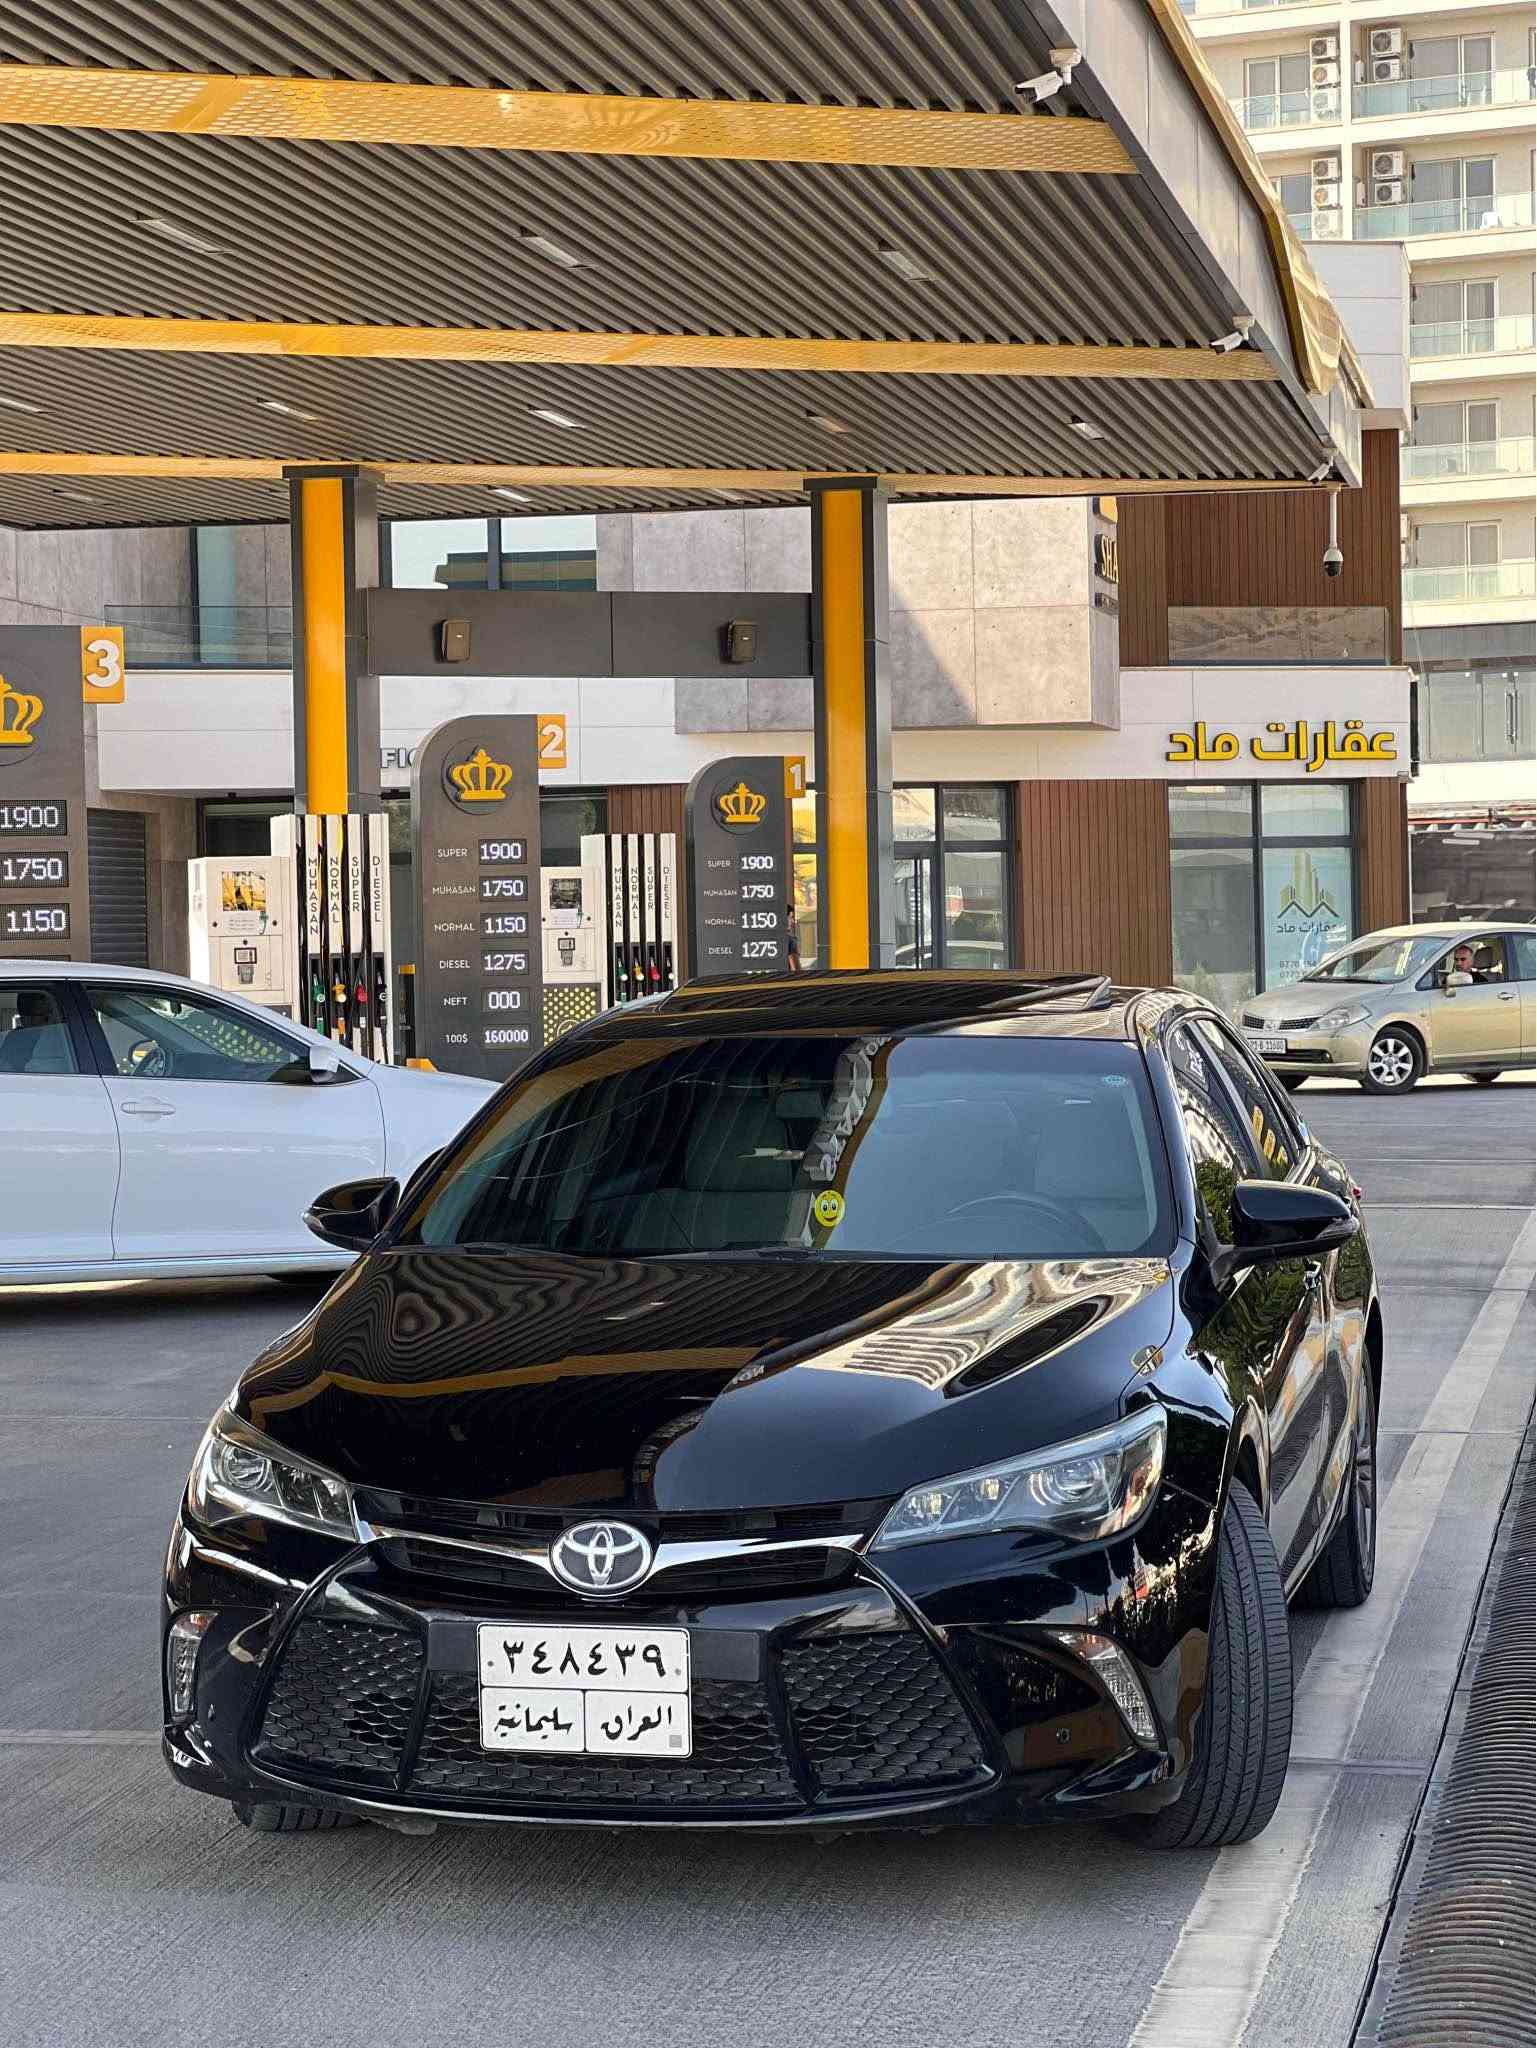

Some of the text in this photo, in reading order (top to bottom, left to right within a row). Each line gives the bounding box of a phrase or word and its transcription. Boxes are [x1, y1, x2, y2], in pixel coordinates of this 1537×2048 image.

[86, 639, 121, 688] 3
[540, 724, 565, 759] 2
[1166, 720, 1398, 773] عقارات ماد
[789, 763, 801, 790] 1
[0, 806, 58, 829] 1900
[437, 842, 521, 860] SUPER 1900
[707, 856, 774, 870] SUPER 1900
[3, 857, 63, 881] 1750
[308, 857, 320, 935] MUHASAN
[330, 857, 341, 923] NORMAL
[352, 856, 360, 912] SUPER
[372, 856, 382, 922] DIESEL
[432, 879, 524, 897] MUHASAN 1750
[631, 867, 640, 919] NORMAL
[647, 867, 655, 910] SUPER
[741, 885, 774, 898] 1750
[6, 908, 67, 933] 1150
[434, 916, 526, 934] NORMAL 1150
[741, 912, 777, 929] 1150
[439, 953, 526, 971] DIESEL 1275
[708, 941, 778, 958] DIESEL 1275
[443, 991, 520, 1009] NEFT 000
[484, 1029, 529, 1044] 160000
[502, 1640, 666, 1678] ٣٤٨٤٣٩
[494, 1703, 672, 1741] سليمانية العراق
